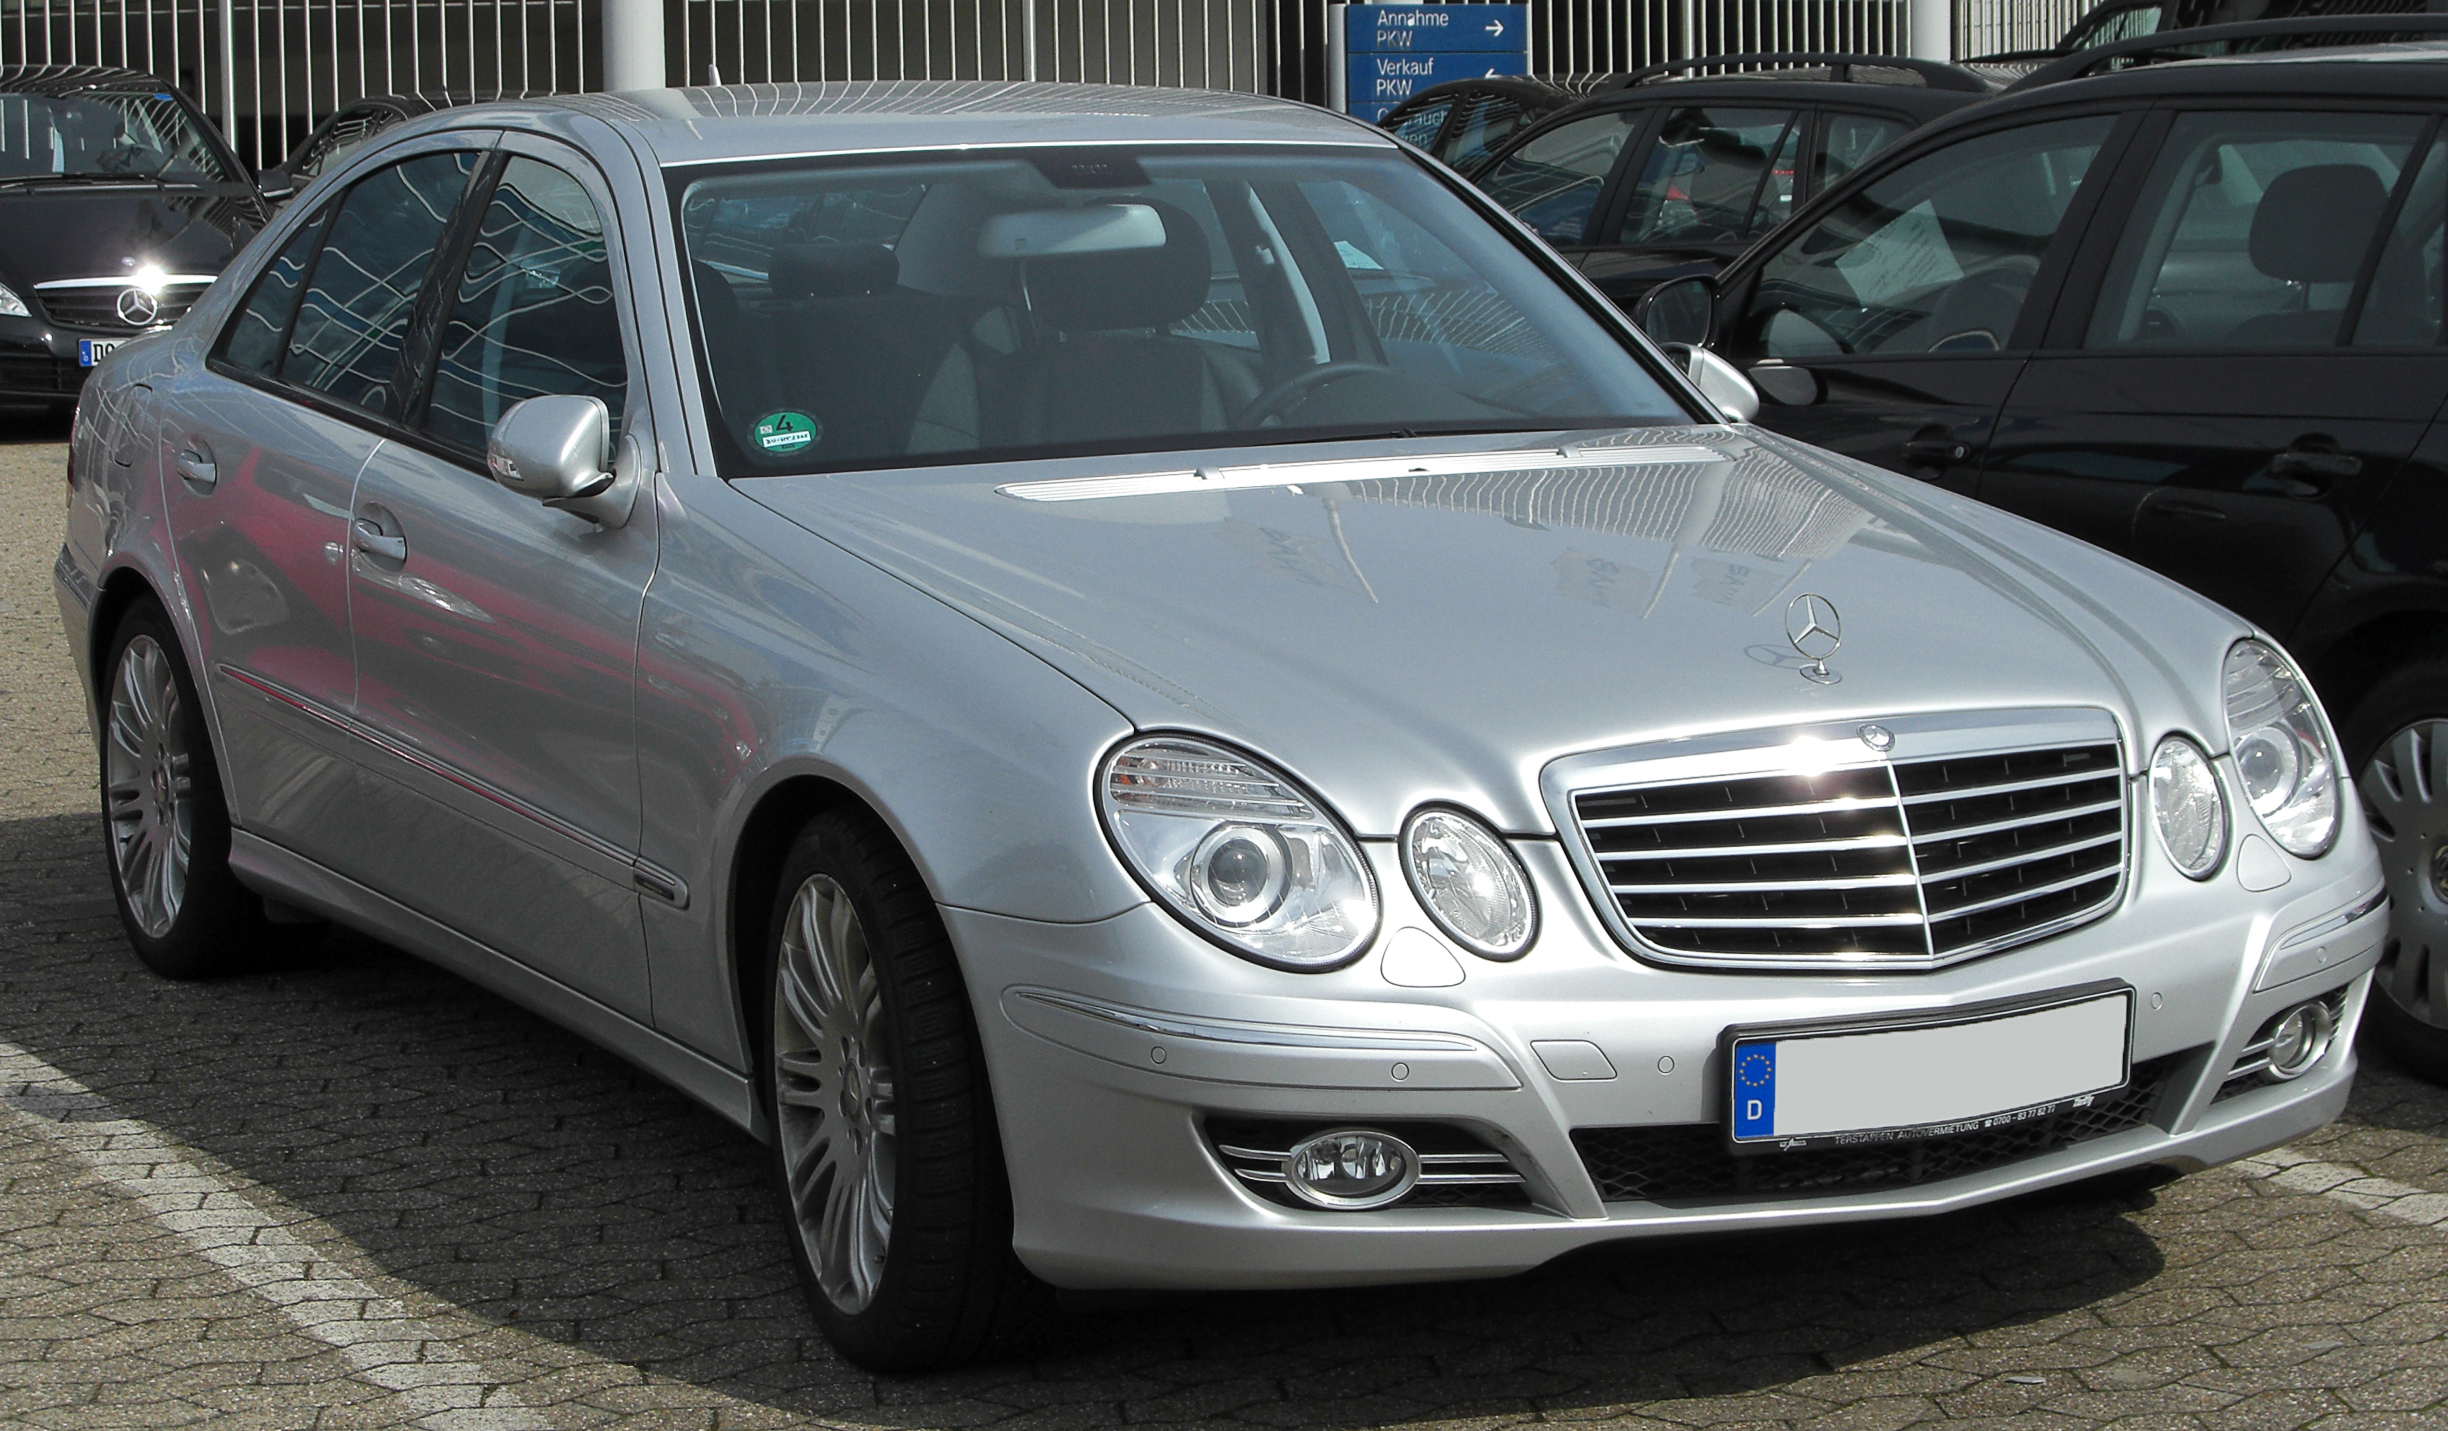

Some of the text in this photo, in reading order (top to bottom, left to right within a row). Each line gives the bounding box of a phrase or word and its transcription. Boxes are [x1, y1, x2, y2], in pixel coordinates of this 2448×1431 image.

[1377, 9, 1449, 26] Annahme
[1377, 30, 1412, 47] PKW
[1376, 57, 1434, 75] Verkauf
[1376, 78, 1412, 96] PKW
[775, 414, 794, 431] 4
[1747, 1099, 1762, 1120] D
[1835, 1132, 1894, 1145] TERSTAPPEN
[1897, 1121, 1979, 1140] AUTOVERMIETUNG
[1993, 1114, 2011, 1126] 0700
